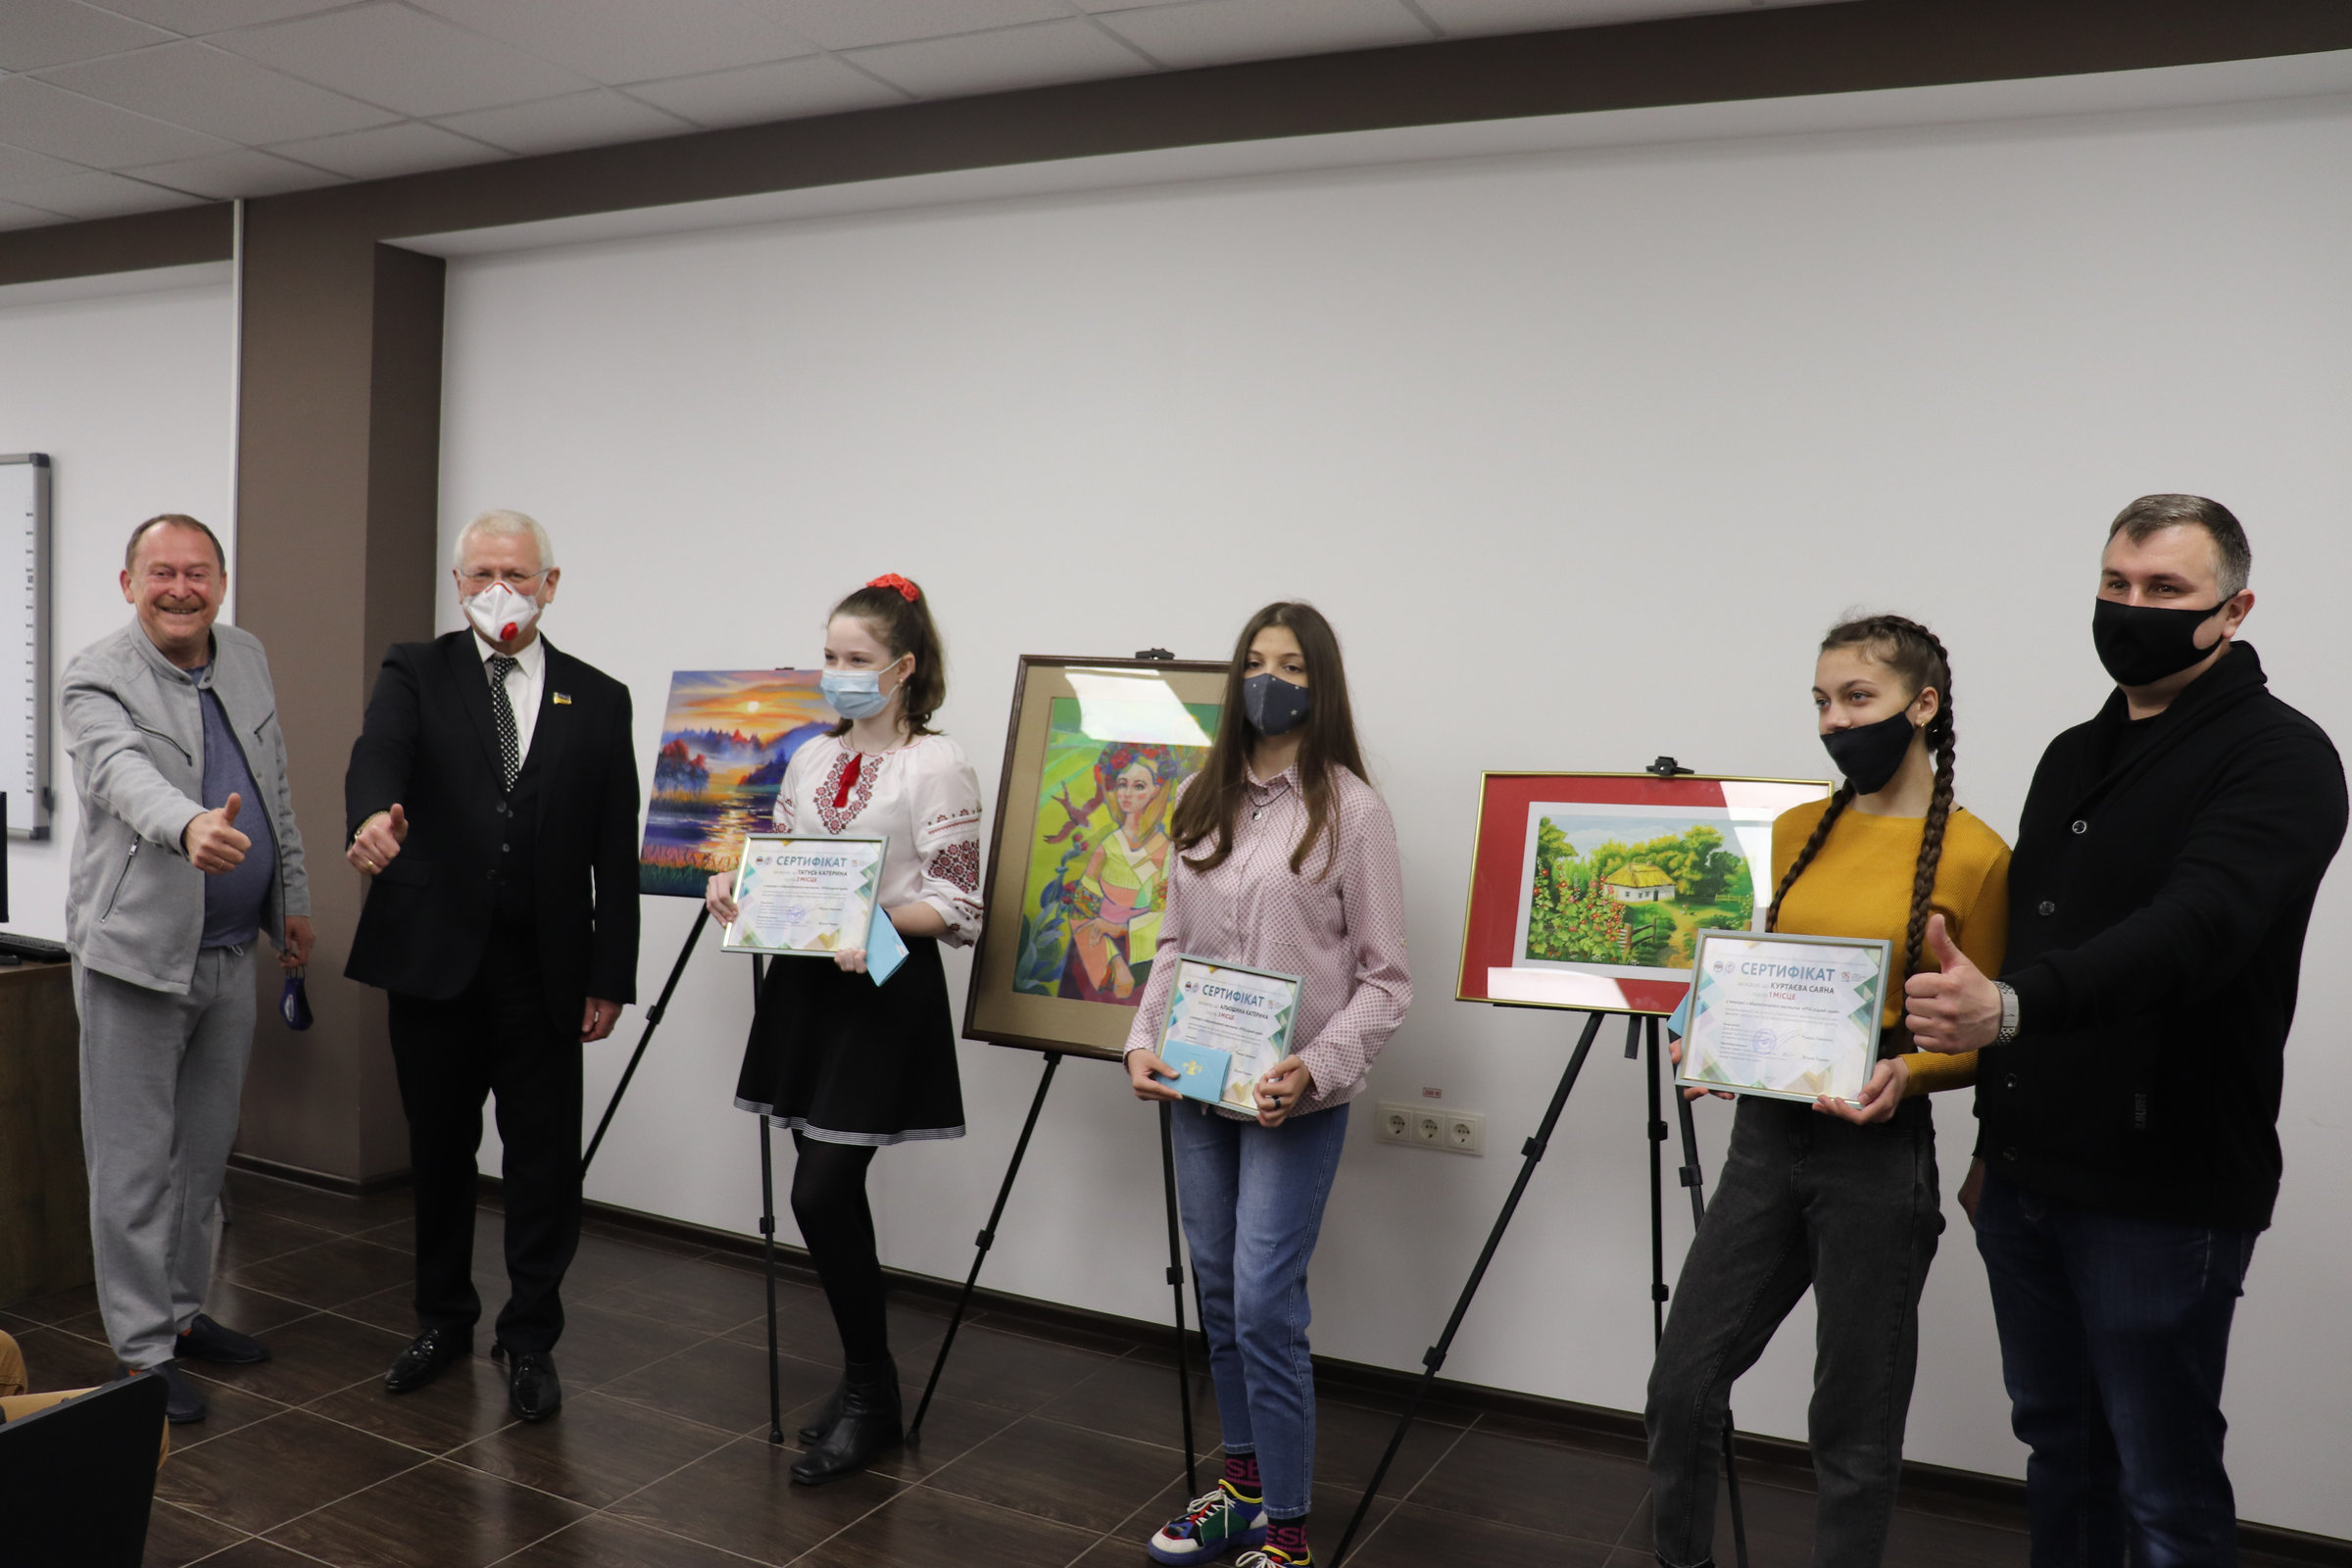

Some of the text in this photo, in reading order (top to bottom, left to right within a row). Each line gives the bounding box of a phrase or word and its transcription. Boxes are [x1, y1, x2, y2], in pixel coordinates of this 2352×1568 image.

[776, 856, 848, 867] СЕРТИФІКАТ
[1740, 961, 1836, 982] СЕРТИФІКАТ
[1770, 982, 1807, 992] КУРТАЄВА
[1808, 985, 1835, 994] САЯНА
[1202, 984, 1265, 1007] СЕРТИФІКАТ
[1246, 1010, 1269, 1019] КАТЕРИНА
